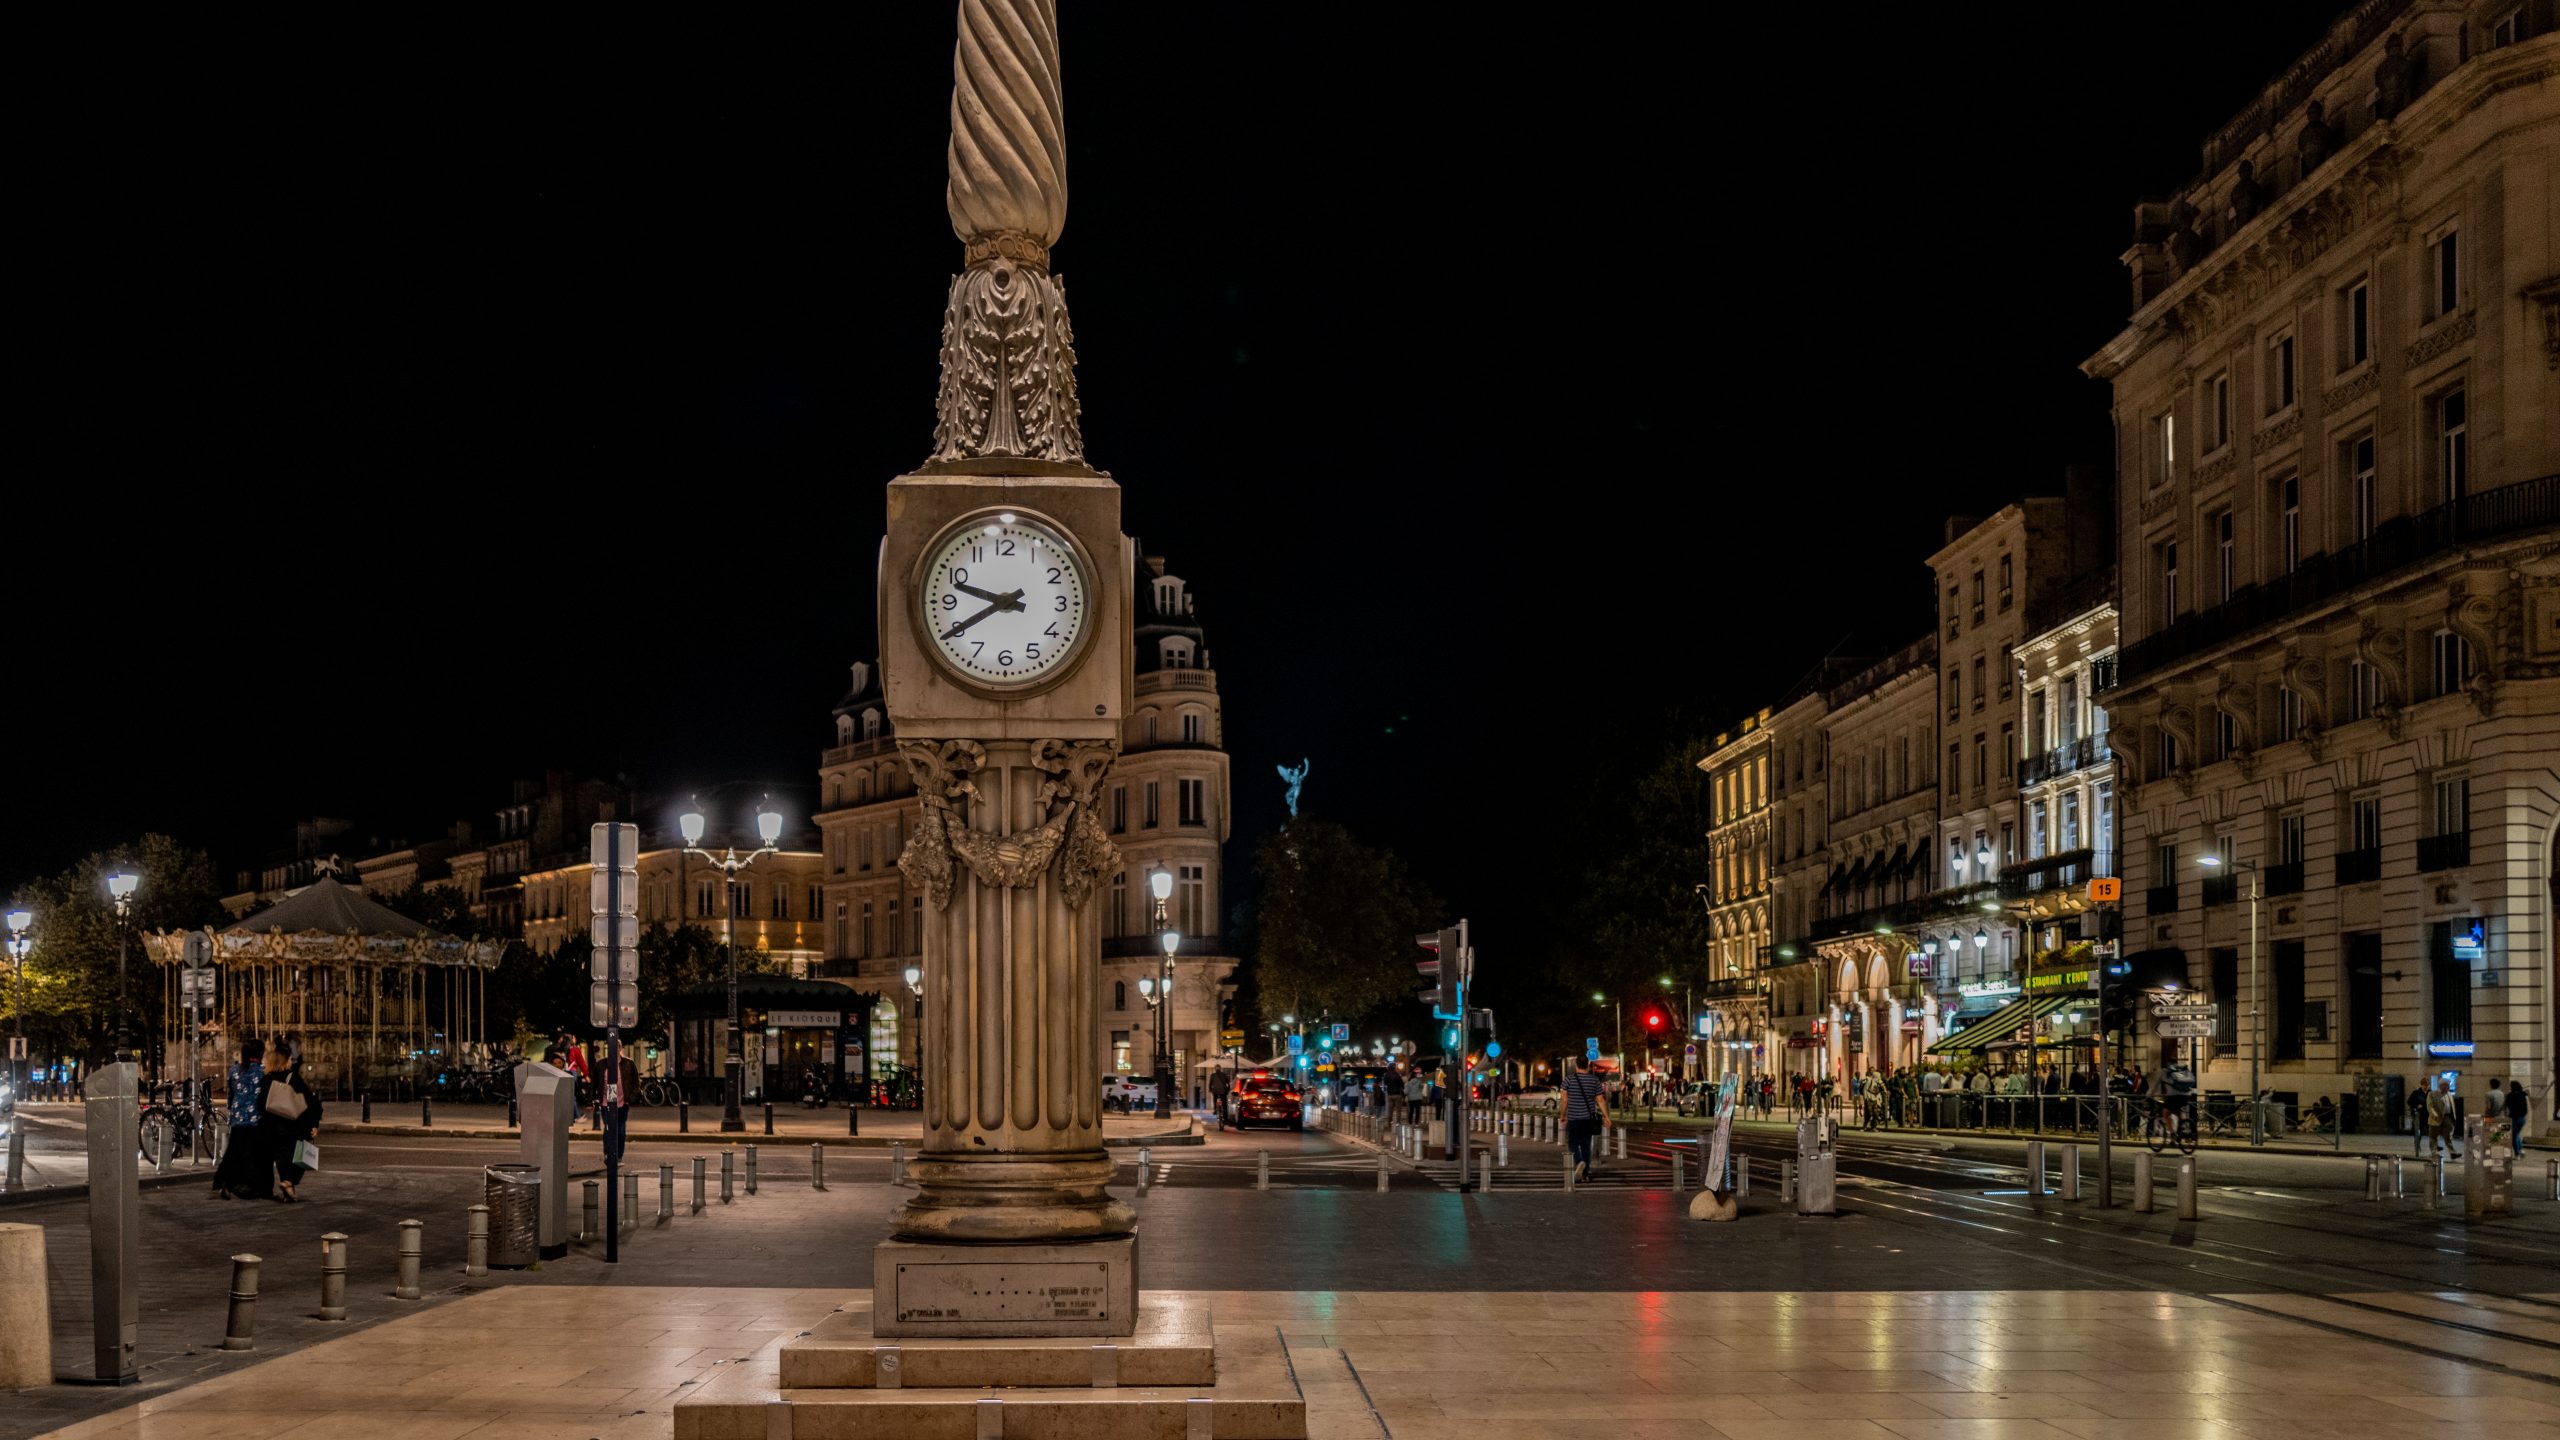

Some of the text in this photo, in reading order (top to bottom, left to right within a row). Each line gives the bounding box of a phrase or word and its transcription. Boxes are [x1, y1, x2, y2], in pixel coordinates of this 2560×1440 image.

[972, 546, 983, 563] 11
[996, 539, 1016, 557] 12
[949, 567, 969, 585] 10
[1047, 567, 1062, 585] 2
[942, 594, 958, 611] 9
[1054, 595, 1067, 612] 3
[951, 621, 965, 638] 8
[1043, 621, 1060, 638] 4
[970, 641, 985, 658] 7
[998, 649, 1013, 667] 6
[1026, 643, 1041, 660] 5
[2099, 884, 2111, 895] 15
[2025, 974, 2062, 988] RSTAURANT
[790, 1015, 837, 1023] KIOSQUE
